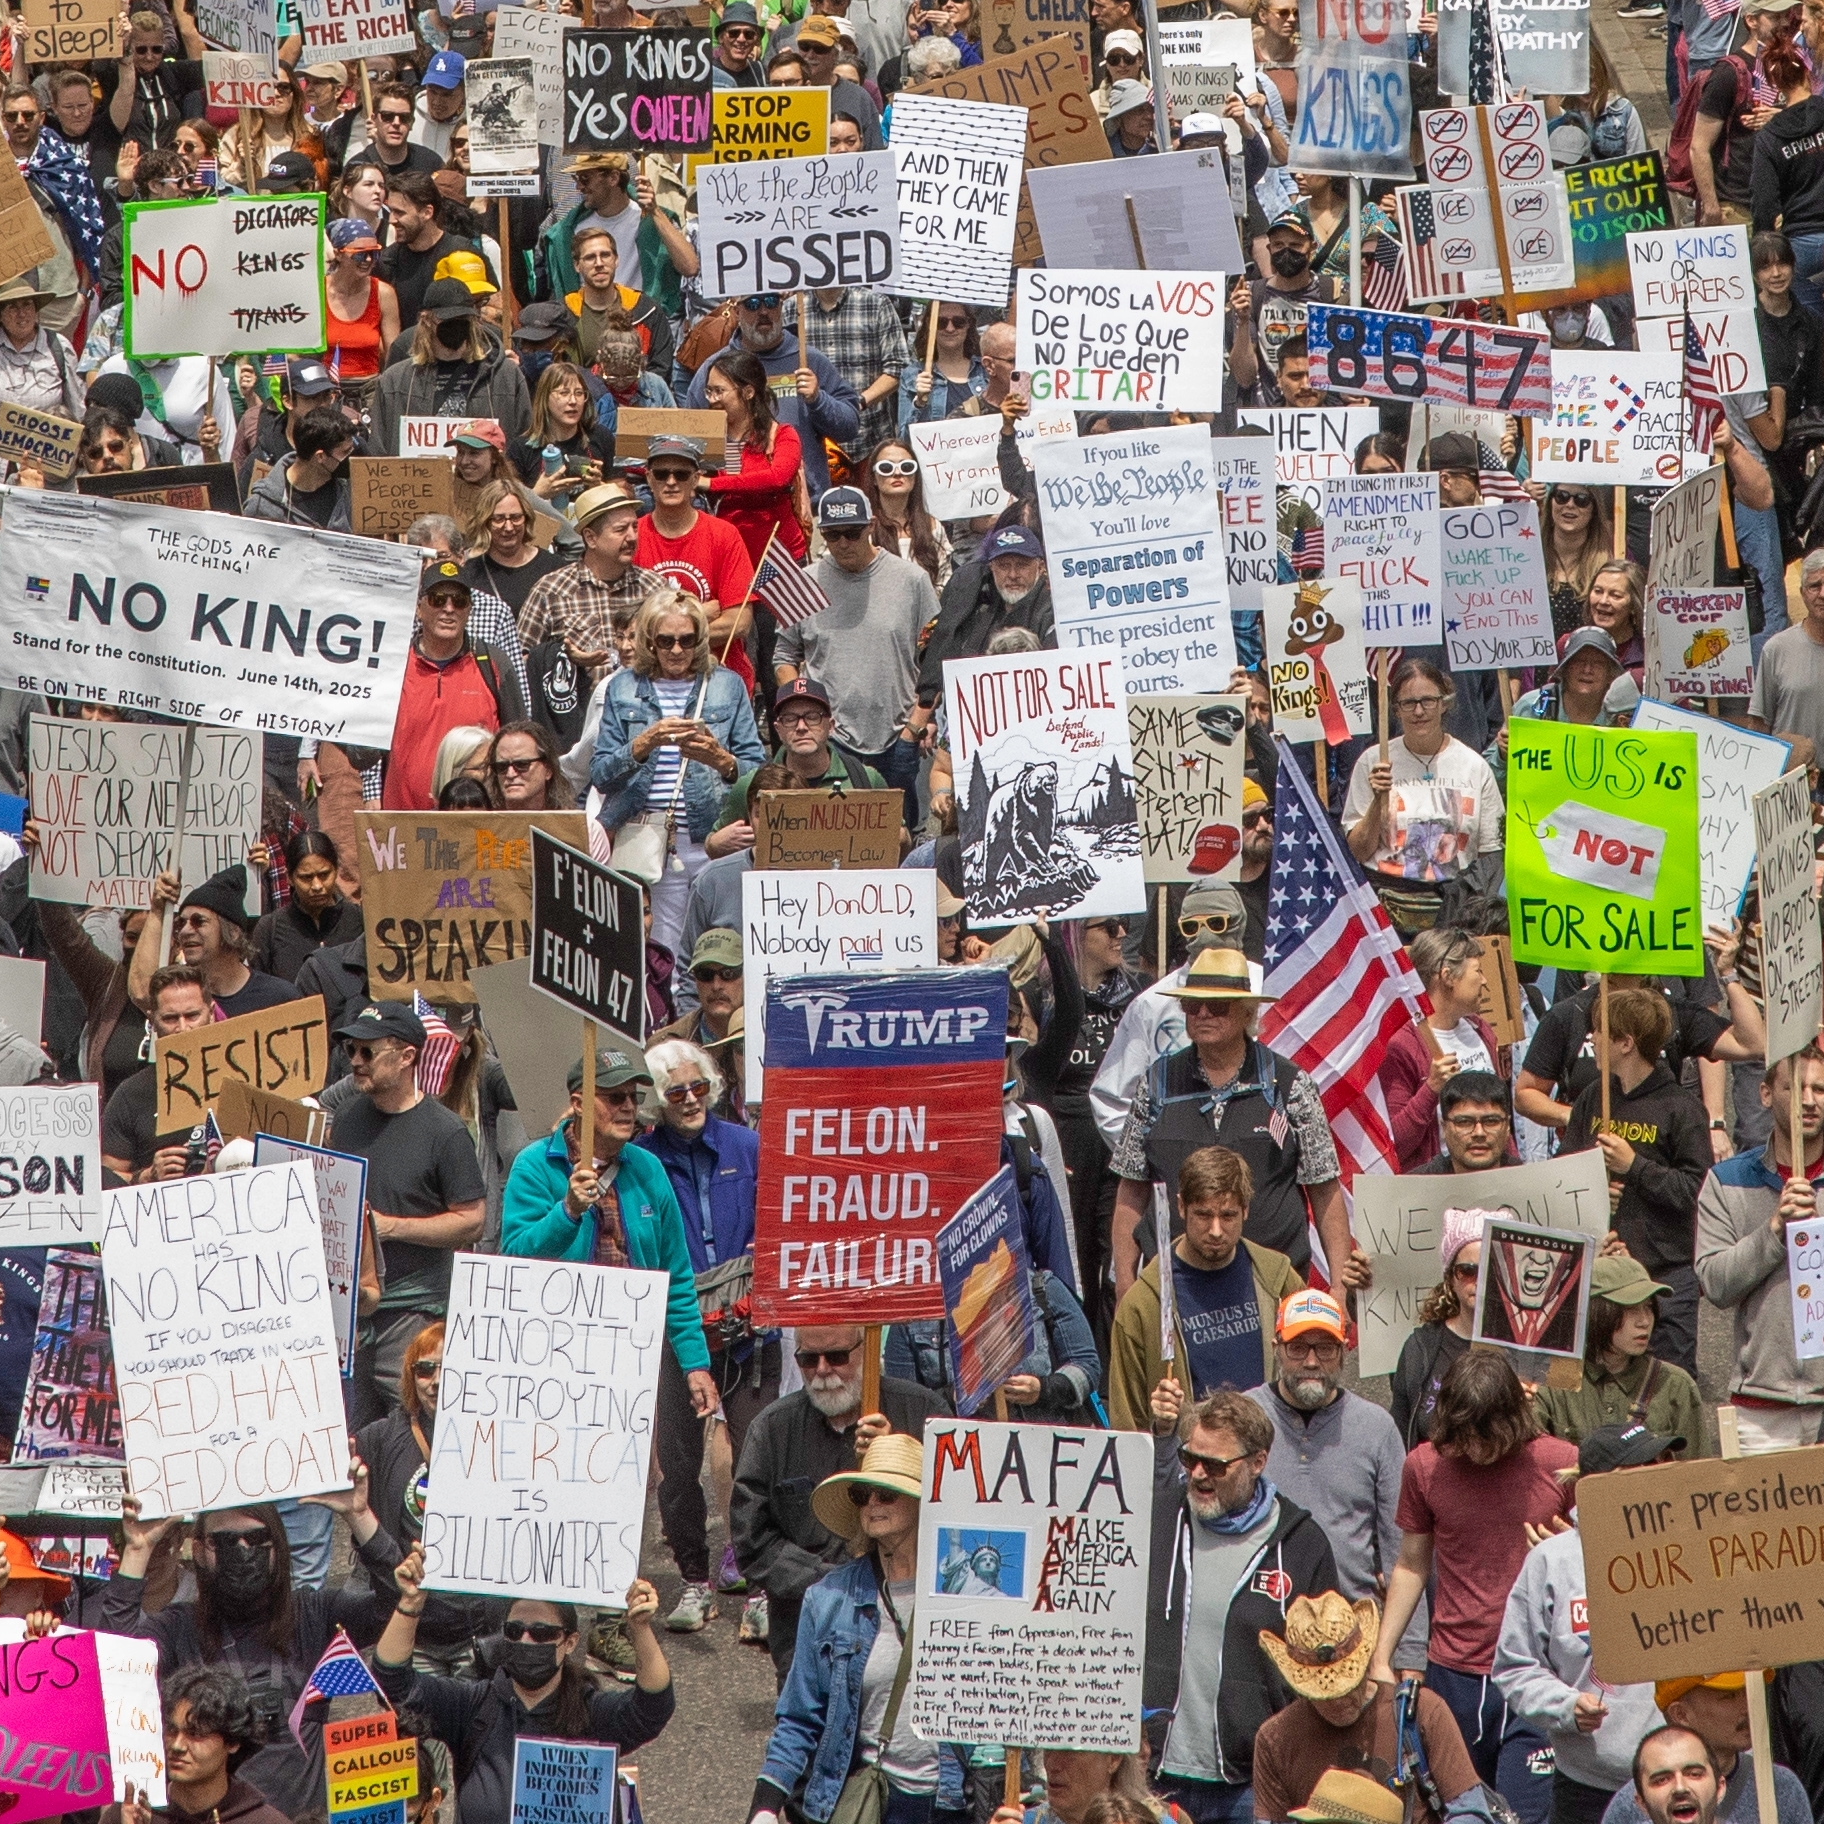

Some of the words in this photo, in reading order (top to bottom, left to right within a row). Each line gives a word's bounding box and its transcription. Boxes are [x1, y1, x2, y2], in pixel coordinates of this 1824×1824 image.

[34, 26, 114, 58] sleep!
[567, 42, 612, 77] NO
[631, 93, 710, 141] QUEEN
[711, 119, 811, 142] ARMING
[726, 96, 791, 118] STOP
[706, 167, 750, 205] We
[757, 166, 797, 197] the
[804, 159, 878, 208] People
[902, 152, 949, 174] AND
[954, 158, 1009, 186] THEN
[771, 207, 821, 229] ARE
[896, 180, 948, 205] THEY
[954, 187, 1009, 216] CAME
[899, 212, 947, 239] FOR
[953, 220, 988, 244] ME
[1634, 240, 1663, 264] NO
[1676, 233, 1737, 259] KINGS
[716, 229, 892, 294] PISSED
[1671, 259, 1703, 281] OR
[1129, 290, 1154, 310] LA
[1157, 282, 1215, 316] VOS
[1035, 343, 1064, 366] NO
[1078, 343, 1180, 374] Pueden
[1135, 322, 1188, 353] Que
[1325, 315, 1538, 408] 8647
[1031, 369, 1166, 410] GRITAR!
[6, 411, 74, 440] CHOOSE
[1061, 547, 1175, 579] Separation
[1182, 540, 1204, 562] of
[1087, 576, 1188, 610] Powers
[68, 574, 167, 631] NO
[192, 592, 384, 668] KING!
[12, 631, 62, 652] Stand
[65, 640, 90, 656] for
[95, 644, 124, 660] the
[128, 648, 227, 679] constitution.
[237, 667, 278, 685] June
[283, 672, 323, 694] 14th,
[329, 681, 372, 700] 2025
[955, 671, 1009, 760] NOT
[1013, 667, 1053, 723] FOR
[1059, 661, 1115, 710] SALE
[1512, 748, 1553, 772] THE
[1564, 735, 1645, 798] US
[1654, 764, 1687, 790] IS
[1573, 829, 1655, 874] NOT
[1521, 899, 1593, 949] FOR
[1600, 907, 1695, 952] SALE
[782, 992, 988, 1055] TRUMP
[785, 1107, 939, 1154] FELON.
[782, 1172, 940, 1223] FRAUD.
[460, 1262, 527, 1305] THE
[542, 1268, 651, 1320] ONLY
[445, 1312, 656, 1373] MINORITY
[442, 1368, 651, 1437] DESTROYING
[435, 1418, 642, 1484] AMERICA
[929, 1430, 1132, 1515] MAFA
[514, 1488, 547, 1512] IS
[426, 1512, 637, 1594] BILLIONAIRES
[1607, 1542, 1692, 1593] OUR
[1632, 1607, 1723, 1651] better
[1741, 1594, 1803, 1629] than
